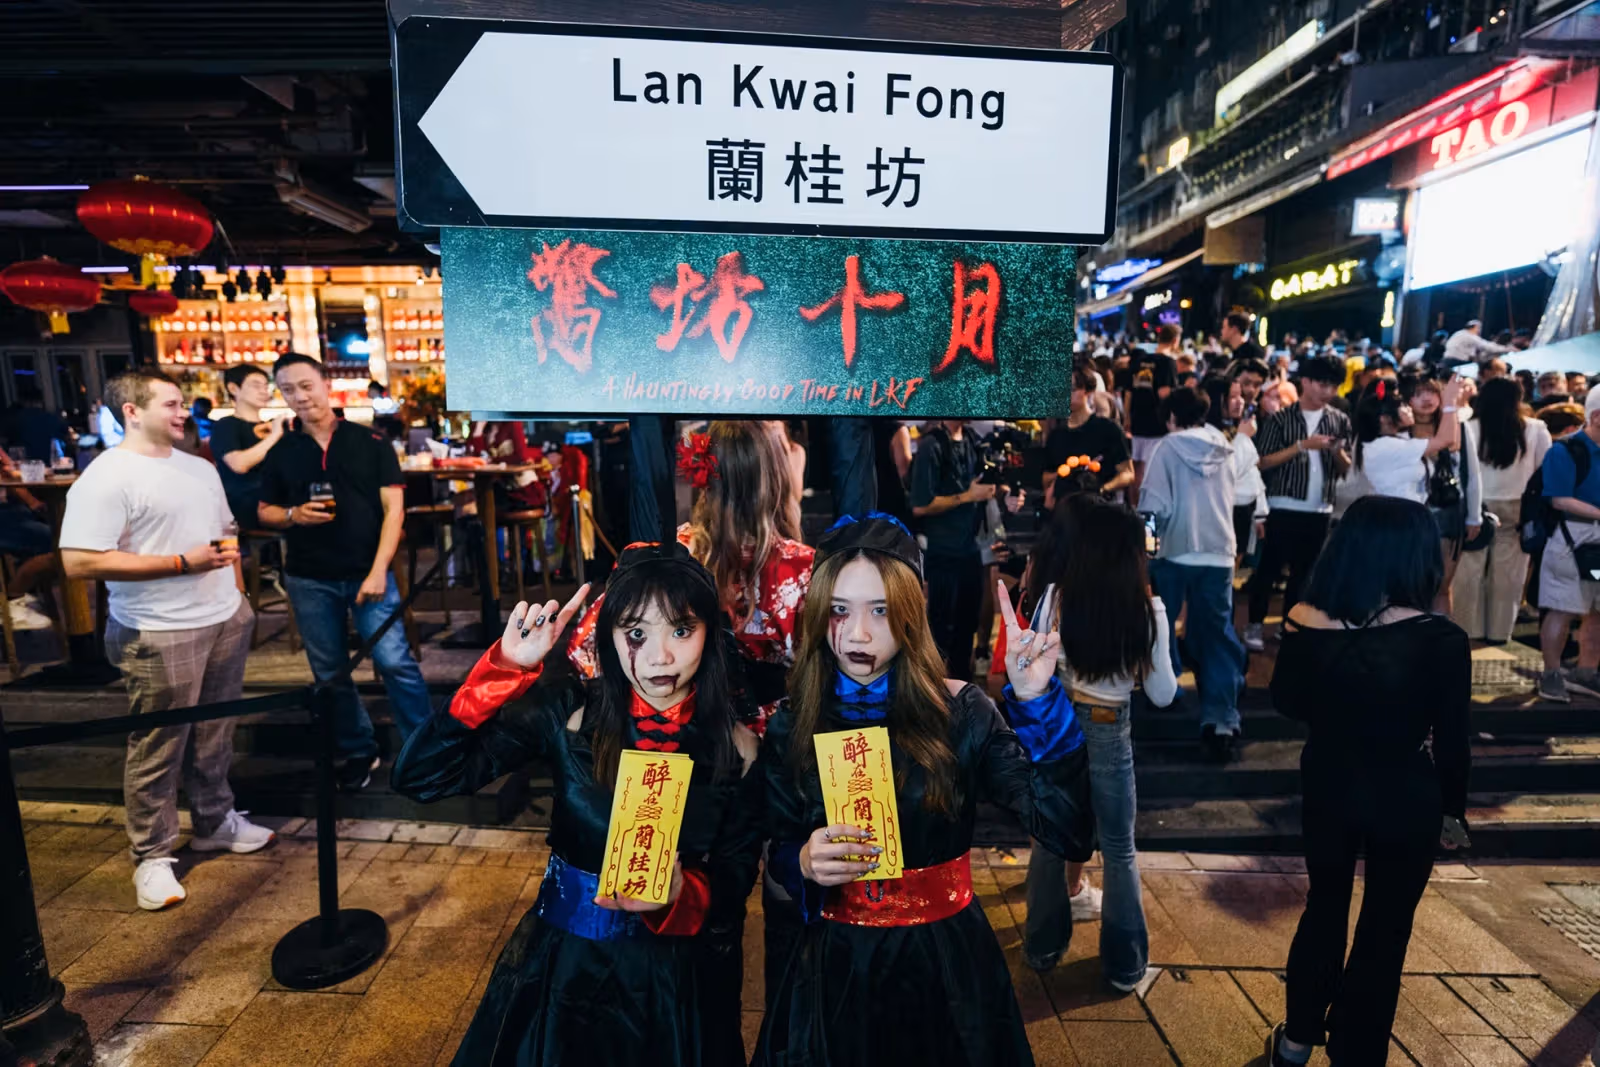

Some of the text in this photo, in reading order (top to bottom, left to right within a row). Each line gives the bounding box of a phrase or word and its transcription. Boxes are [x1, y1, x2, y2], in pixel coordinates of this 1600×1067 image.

[612, 57, 1005, 131] Lan Kwai Fong
[1431, 101, 1529, 169] TAO
[705, 137, 926, 208] 蘭桂坊
[602, 375, 619, 400] A
[623, 371, 735, 403] HAUNTINGLY
[741, 378, 794, 400] GOOD
[869, 376, 924, 409] LKF
